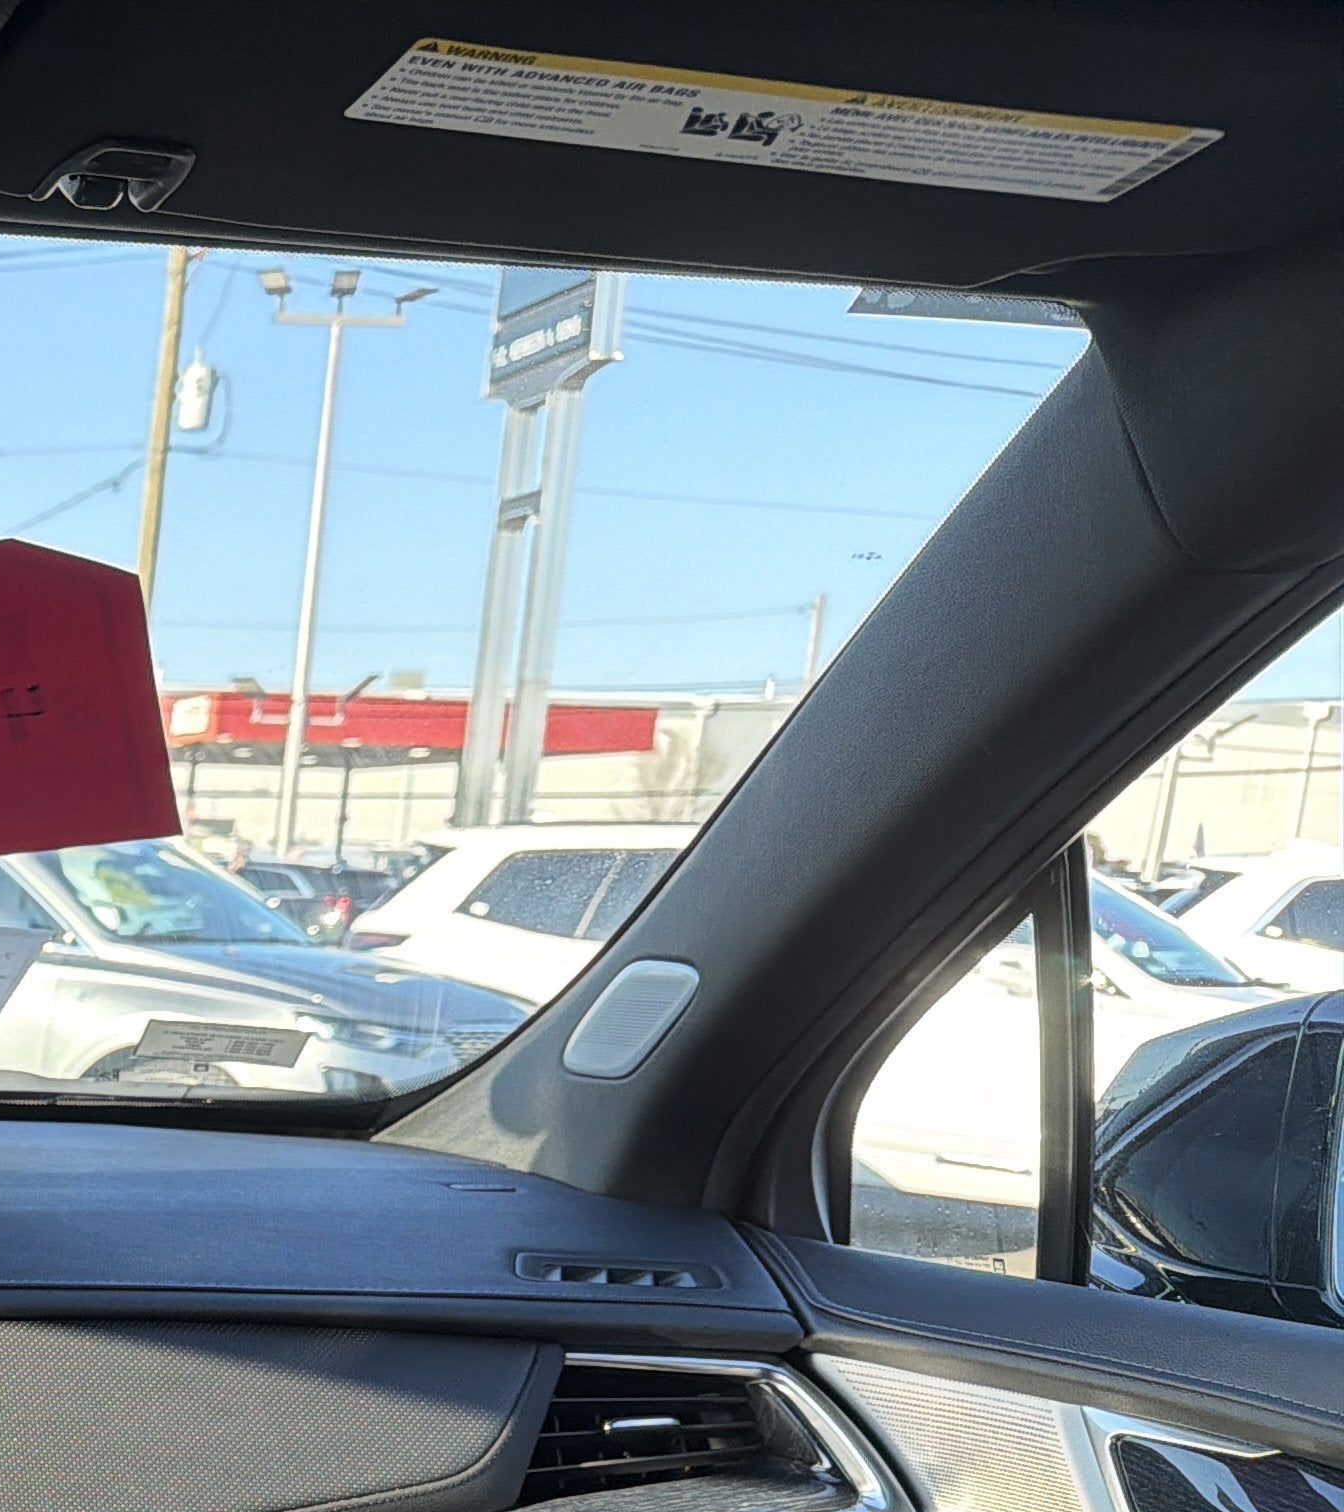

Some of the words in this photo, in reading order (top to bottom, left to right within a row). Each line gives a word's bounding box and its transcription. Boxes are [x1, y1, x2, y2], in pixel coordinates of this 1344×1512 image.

[445, 45, 538, 67] WARNING
[408, 55, 455, 70] EVEN
[461, 60, 507, 76] WITH
[513, 67, 611, 88] ADVANCED
[614, 79, 649, 93] AIR
[652, 83, 702, 99] BAGS
